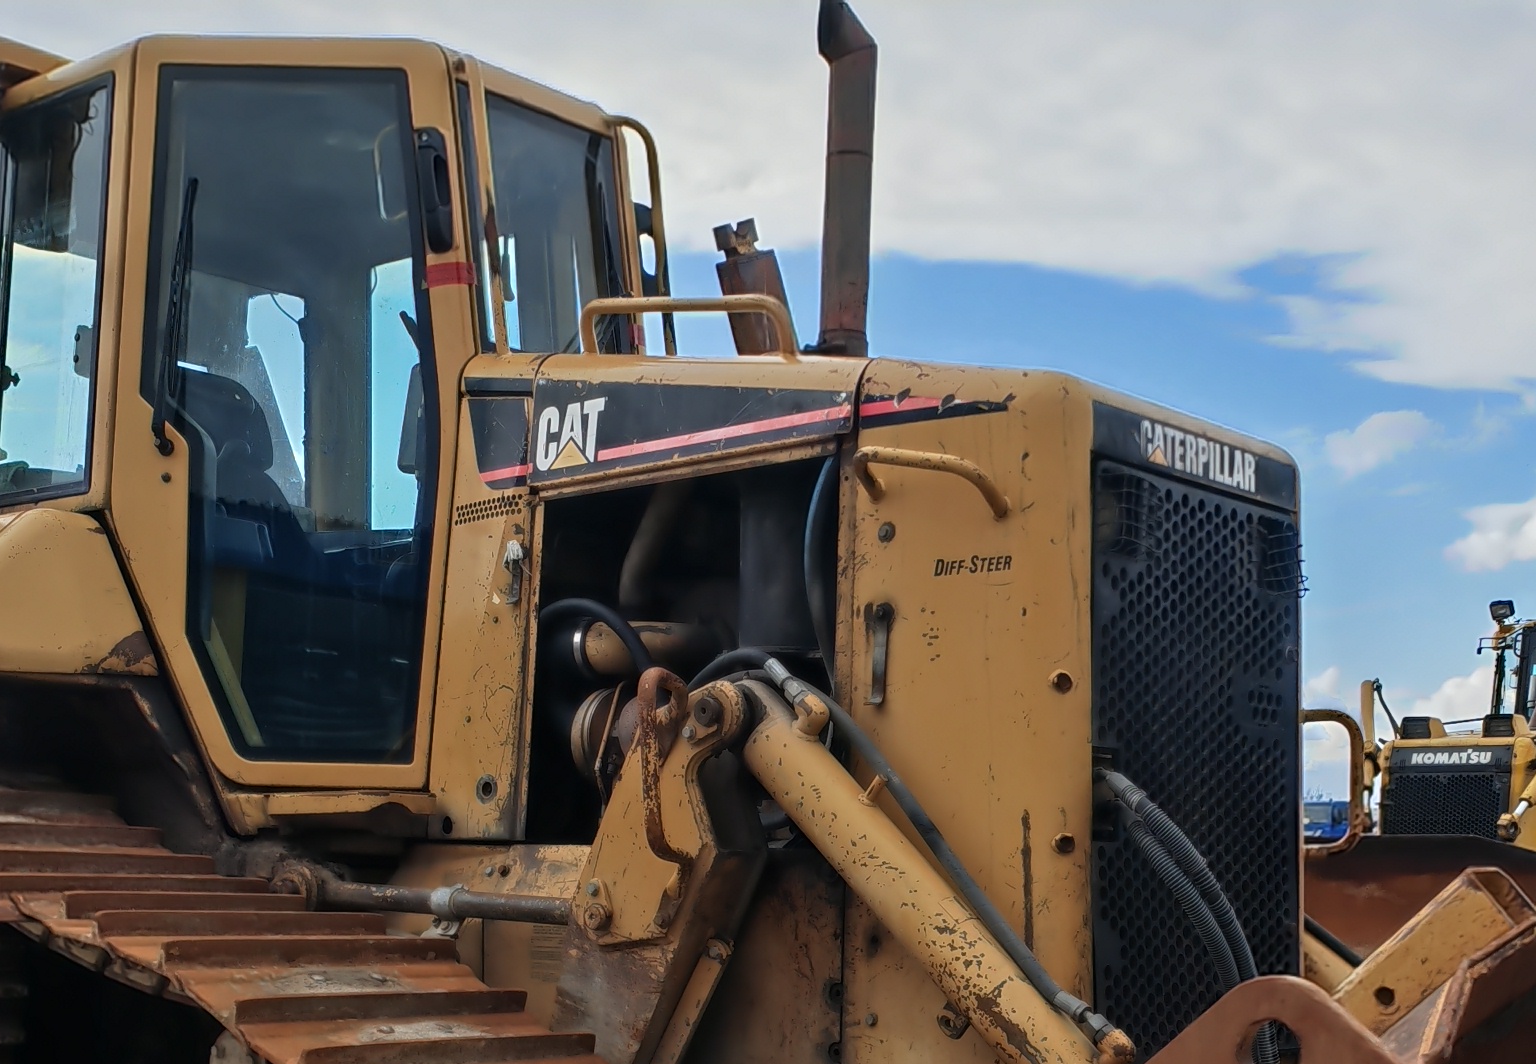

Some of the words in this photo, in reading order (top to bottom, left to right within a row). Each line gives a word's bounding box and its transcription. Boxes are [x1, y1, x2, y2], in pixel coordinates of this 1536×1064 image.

[536, 397, 606, 471] CAT
[1140, 420, 1256, 493] CATERPILLAR
[1411, 749, 1492, 764] KOMATSU
